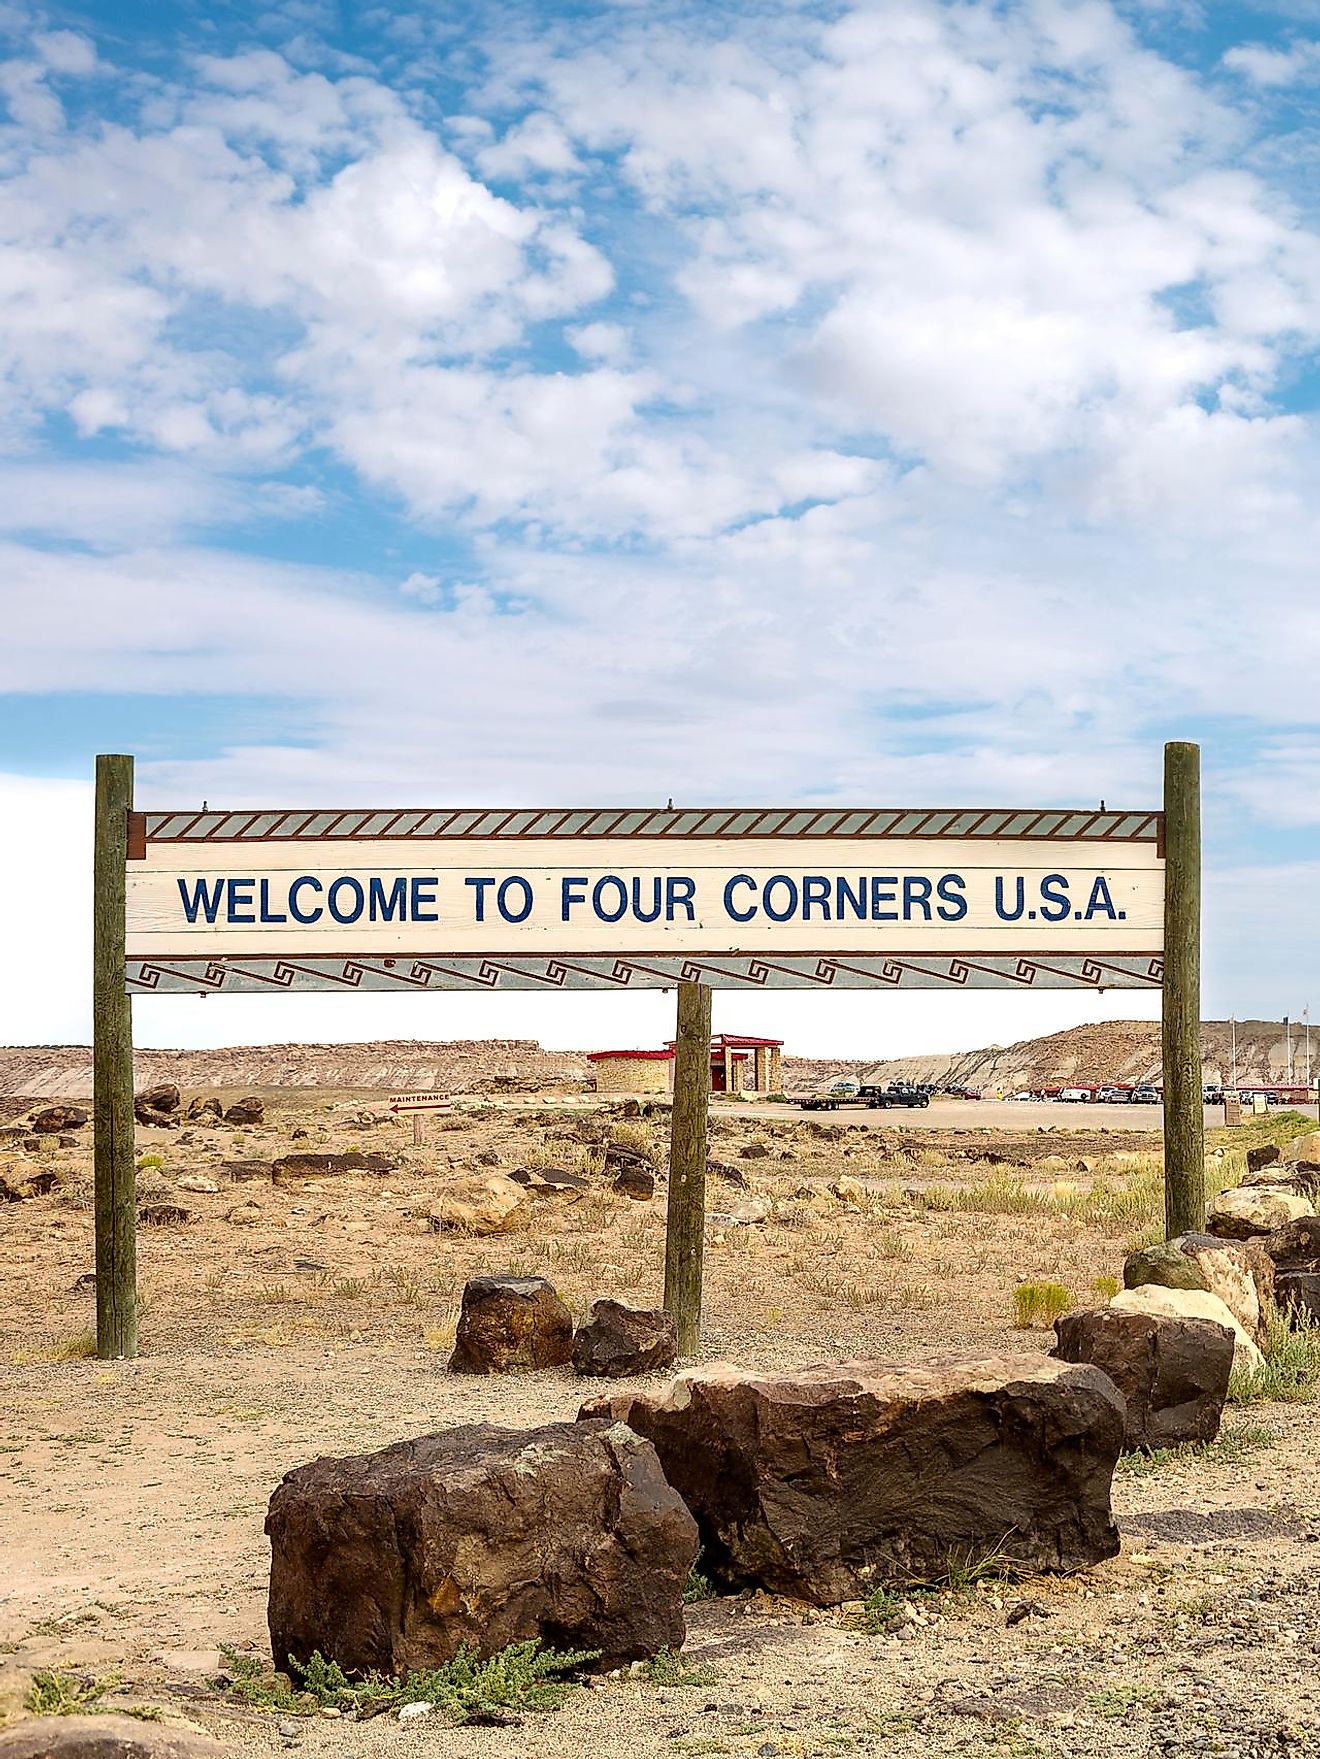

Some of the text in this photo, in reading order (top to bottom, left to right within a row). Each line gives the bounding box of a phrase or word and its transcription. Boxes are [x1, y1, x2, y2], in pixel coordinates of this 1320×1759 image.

[178, 873, 1127, 925] WELCOME TO FOUR CORNERS U.S.A.
[389, 1094, 450, 1103] MAINTENANCE
